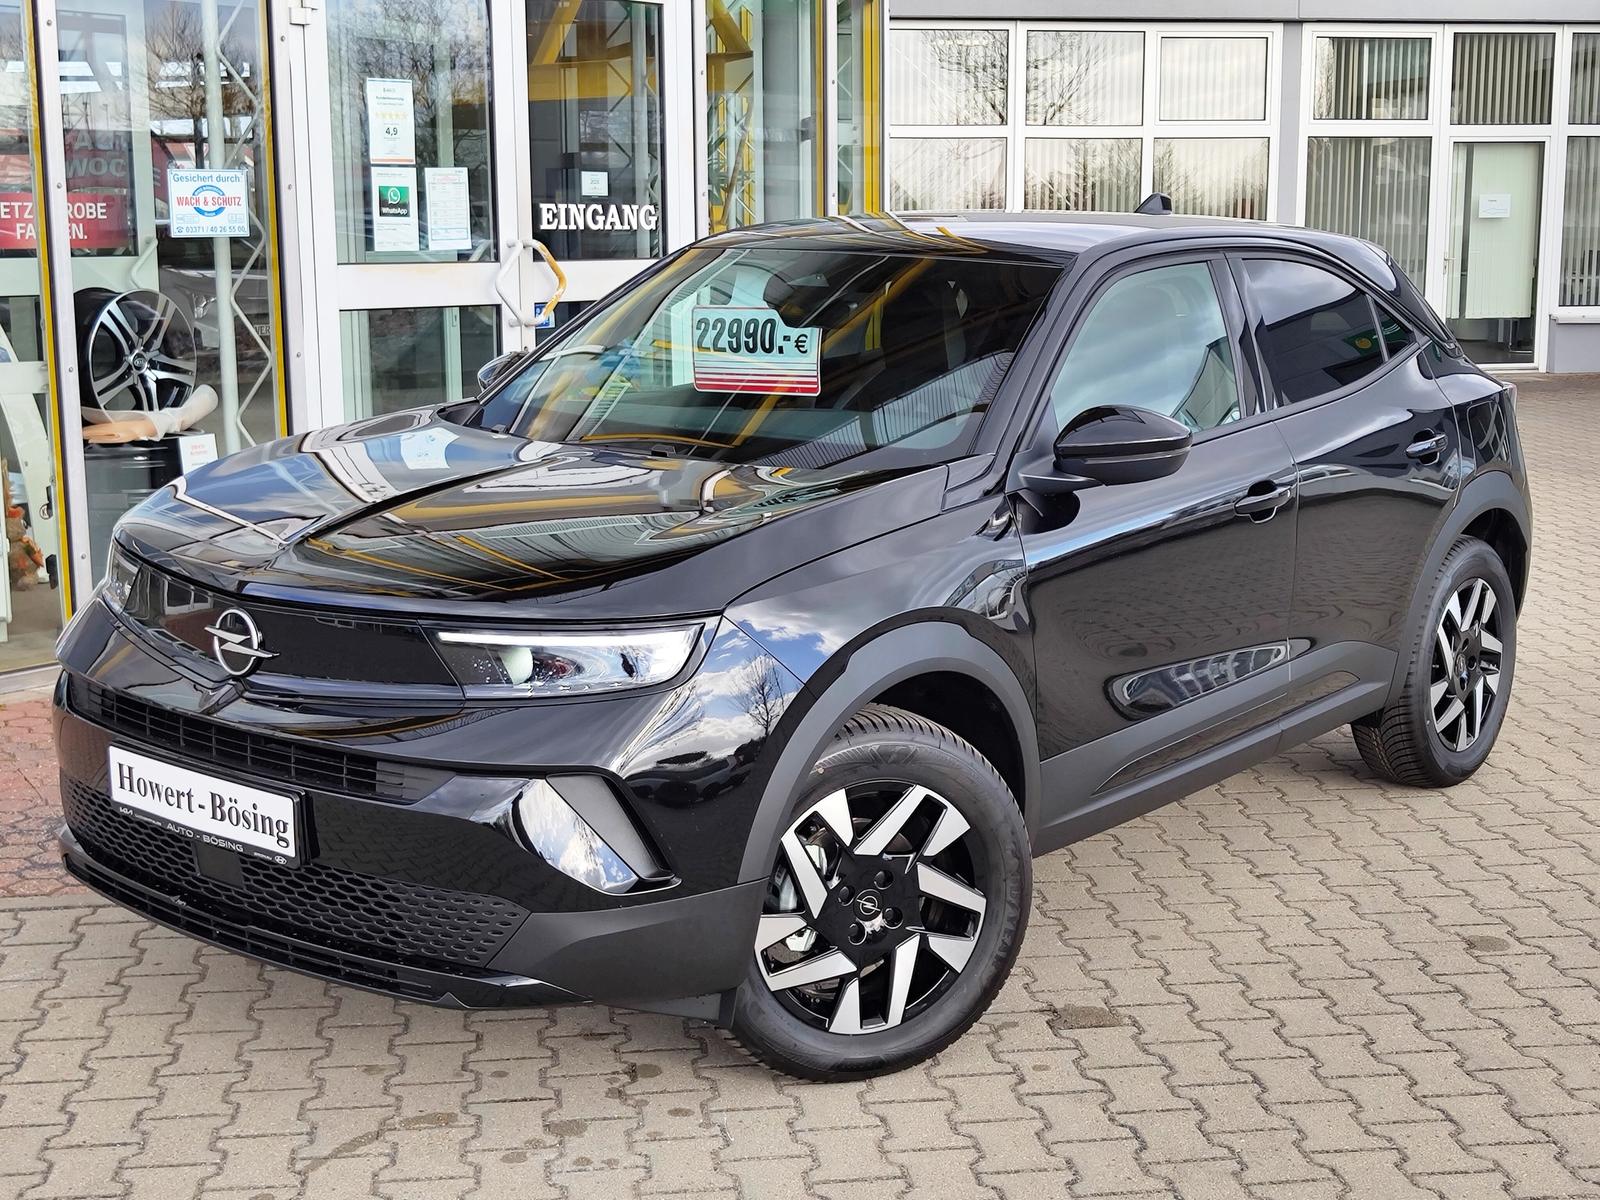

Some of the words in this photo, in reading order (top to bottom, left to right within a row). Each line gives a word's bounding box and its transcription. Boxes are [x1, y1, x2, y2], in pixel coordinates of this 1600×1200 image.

[385, 127, 398, 136] 4,9
[173, 173, 213, 183] Gesichert
[216, 173, 240, 183] durch
[176, 196, 200, 207] WACH
[203, 196, 209, 207] &
[211, 196, 242, 207] SCHUTZ
[0, 201, 34, 219] ETZ
[67, 203, 107, 219] ROBE
[381, 207, 408, 215] WhatsApp
[539, 202, 658, 231] EINGANG
[166, 822, 194, 838] AUTO
